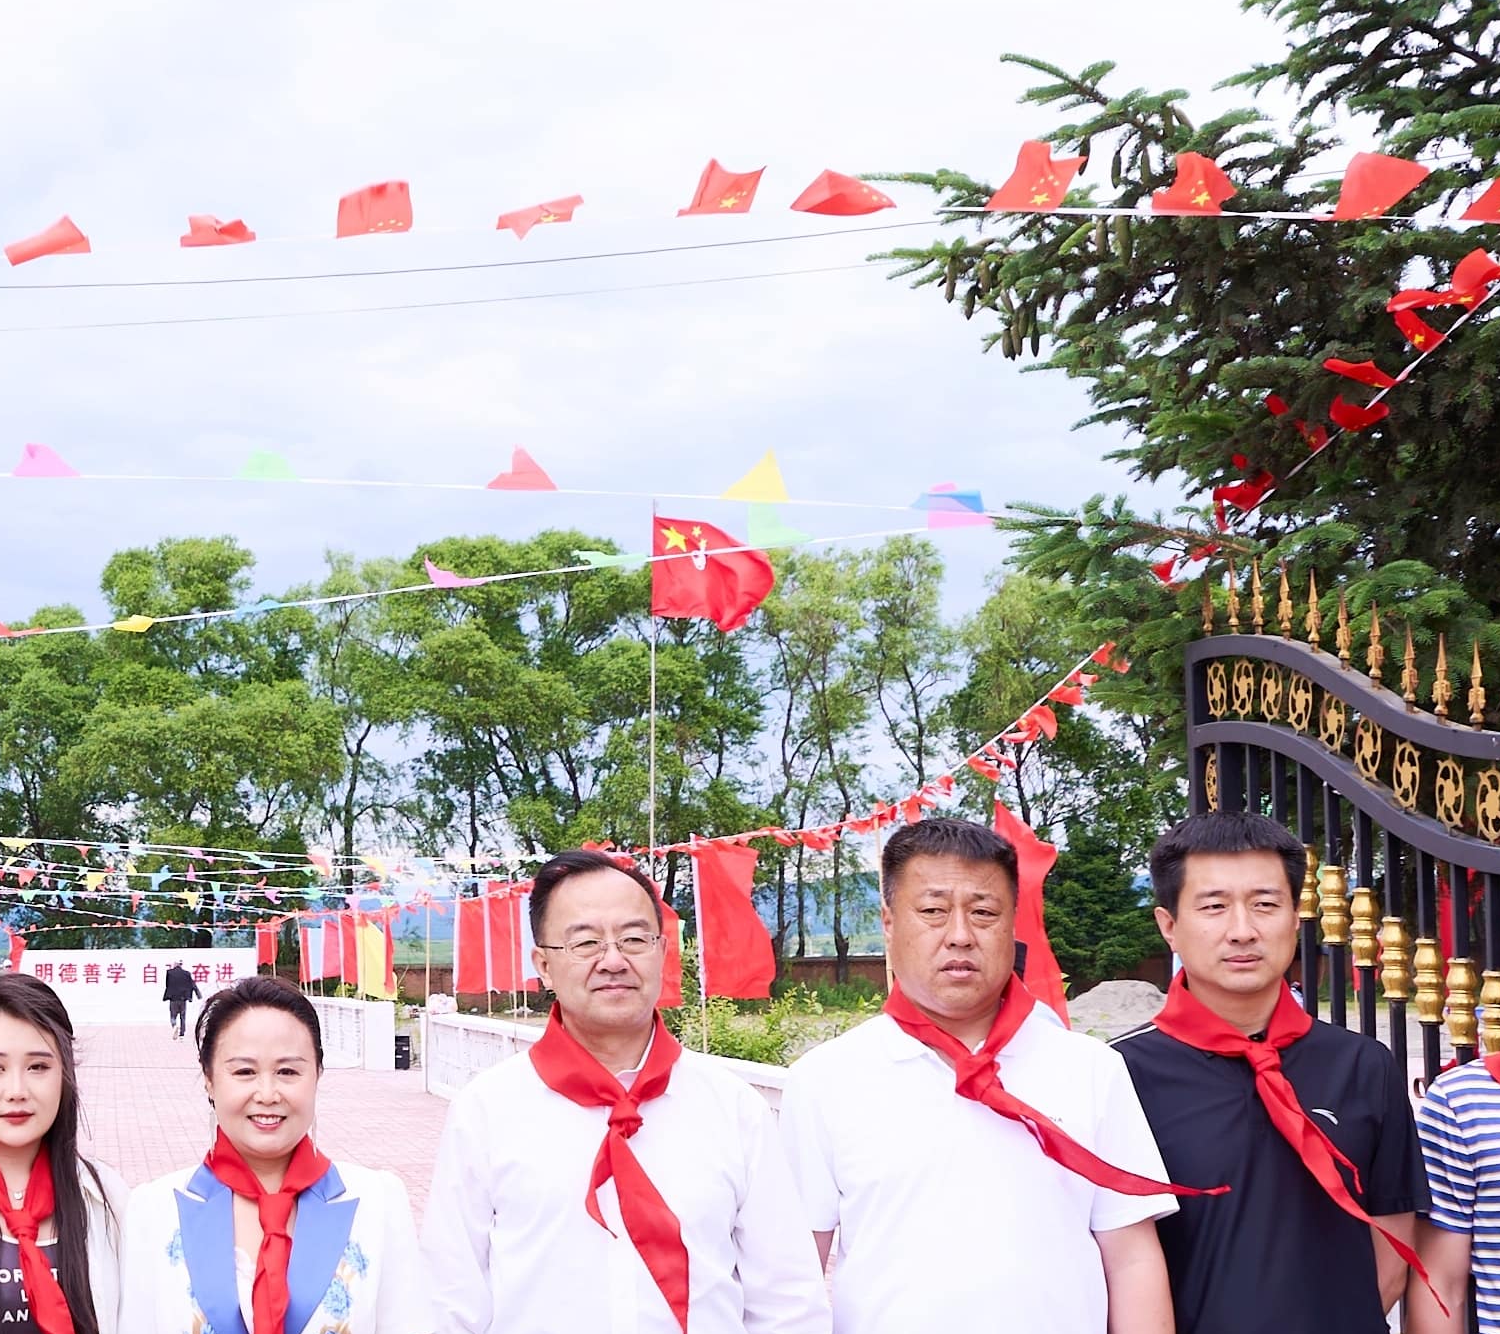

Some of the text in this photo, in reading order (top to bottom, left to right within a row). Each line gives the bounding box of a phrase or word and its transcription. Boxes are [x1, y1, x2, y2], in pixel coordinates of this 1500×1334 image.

[34, 962, 235, 984] 明德善学 自奋进
